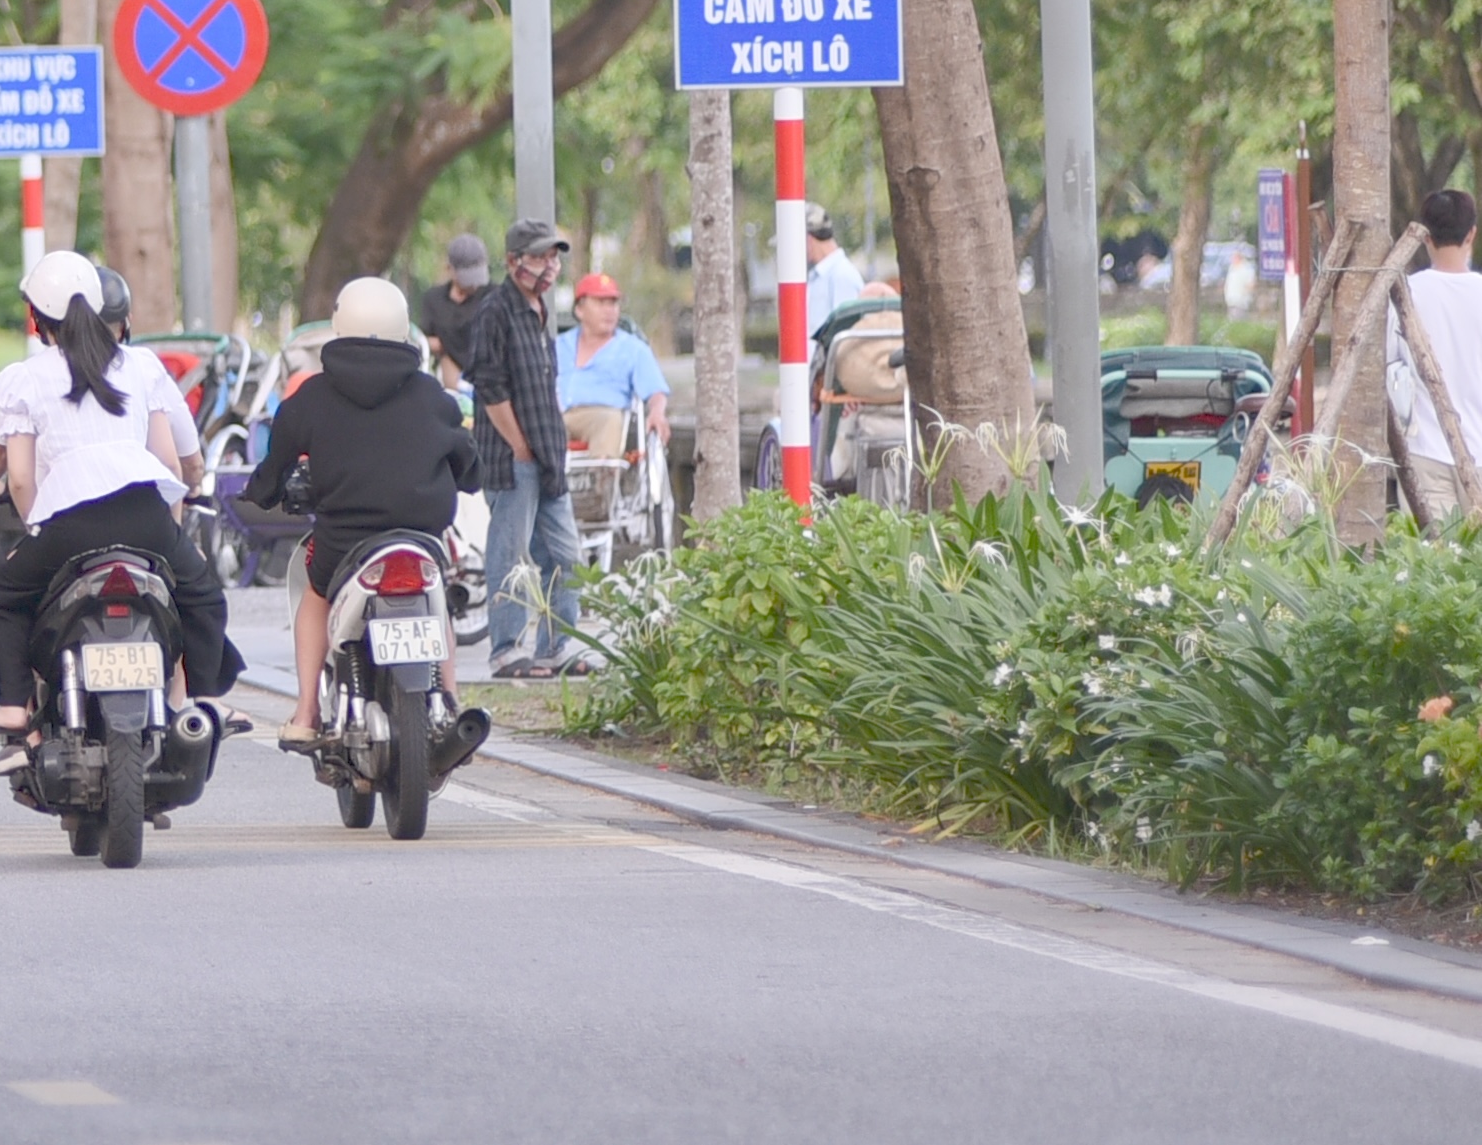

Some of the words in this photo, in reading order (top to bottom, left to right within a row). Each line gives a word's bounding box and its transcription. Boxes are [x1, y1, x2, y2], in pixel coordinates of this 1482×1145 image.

[731, 36, 803, 74] XÍCH
[813, 34, 850, 72] LÔ
[34, 54, 76, 84] VỰC
[55, 88, 85, 115] XE
[42, 118, 70, 148] LÔ
[381, 621, 431, 641] 75-AF
[95, 646, 147, 665] 75-B1
[378, 640, 442, 660] 071.48
[90, 667, 157, 687] 234.25
